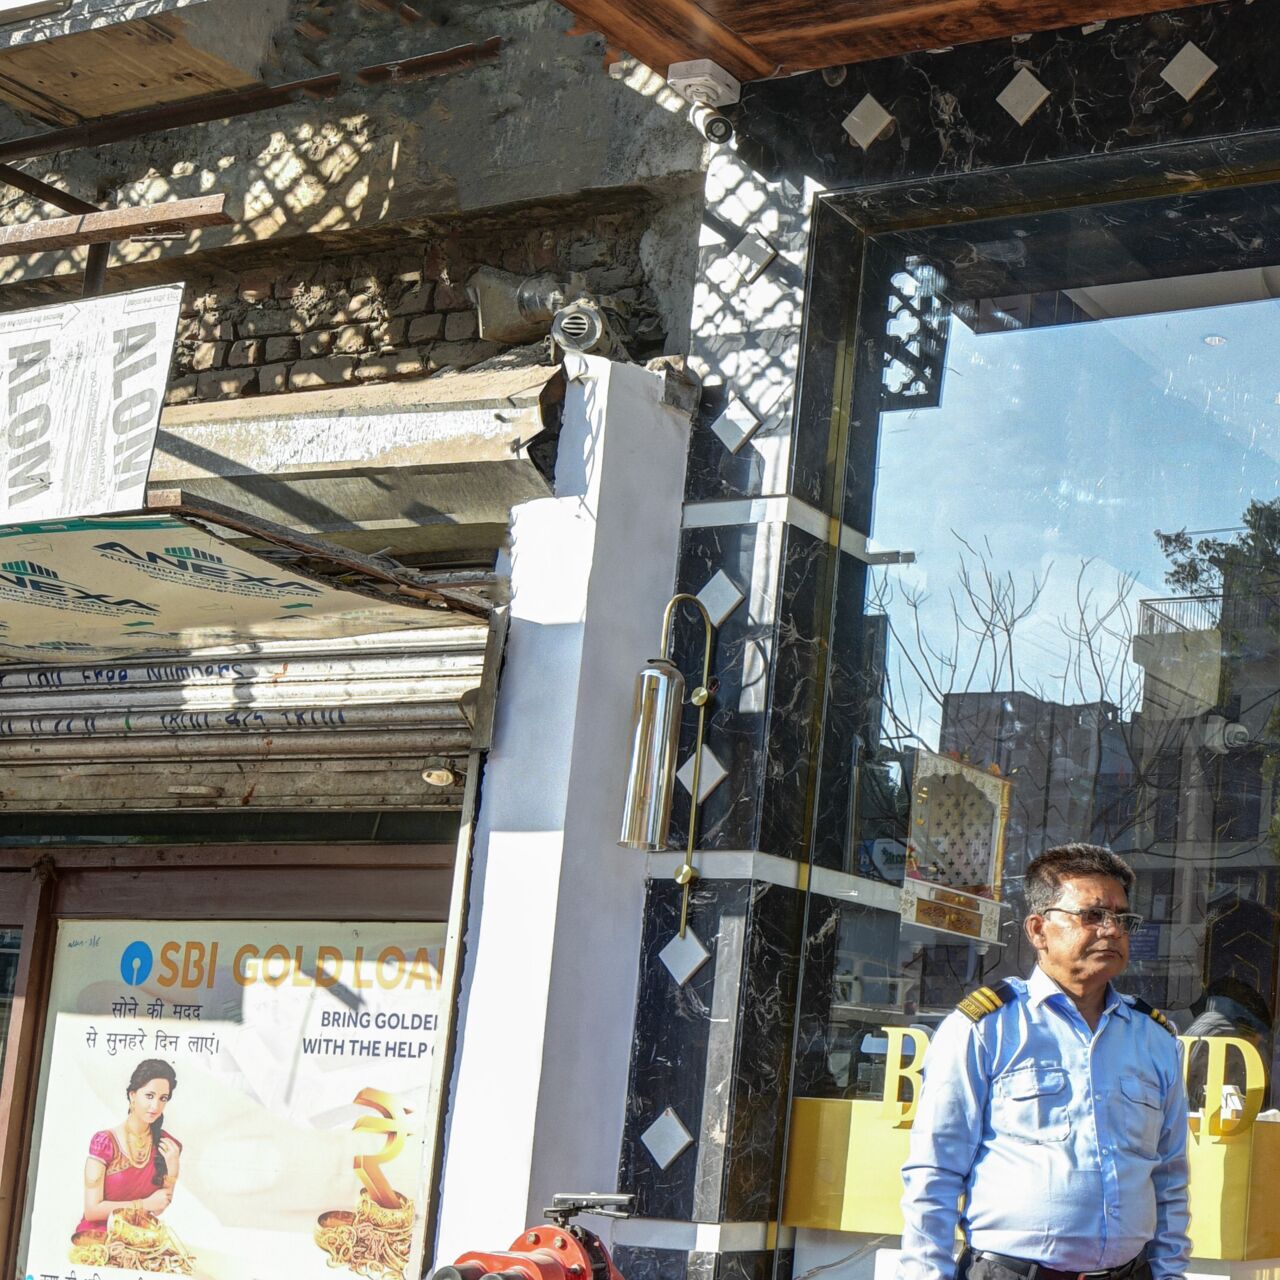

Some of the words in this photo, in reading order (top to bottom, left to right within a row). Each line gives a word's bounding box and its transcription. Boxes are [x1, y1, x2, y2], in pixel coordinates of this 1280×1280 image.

[93, 541, 324, 594] ANEXA
[100, 553, 181, 578] ALUMINIUM
[157, 941, 219, 989] SBI
[233, 943, 343, 988] GOLD
[111, 996, 139, 1020] सोने
[146, 997, 165, 1020] की
[172, 1004, 204, 1021] मदद
[321, 1010, 371, 1030] BRING
[86, 1026, 99, 1049] से
[106, 1028, 148, 1056] सुनहरे
[154, 1029, 180, 1052] दिन
[302, 1037, 345, 1056] WITH
[348, 1039, 382, 1058] THE
[384, 1041, 428, 1059] HELP
